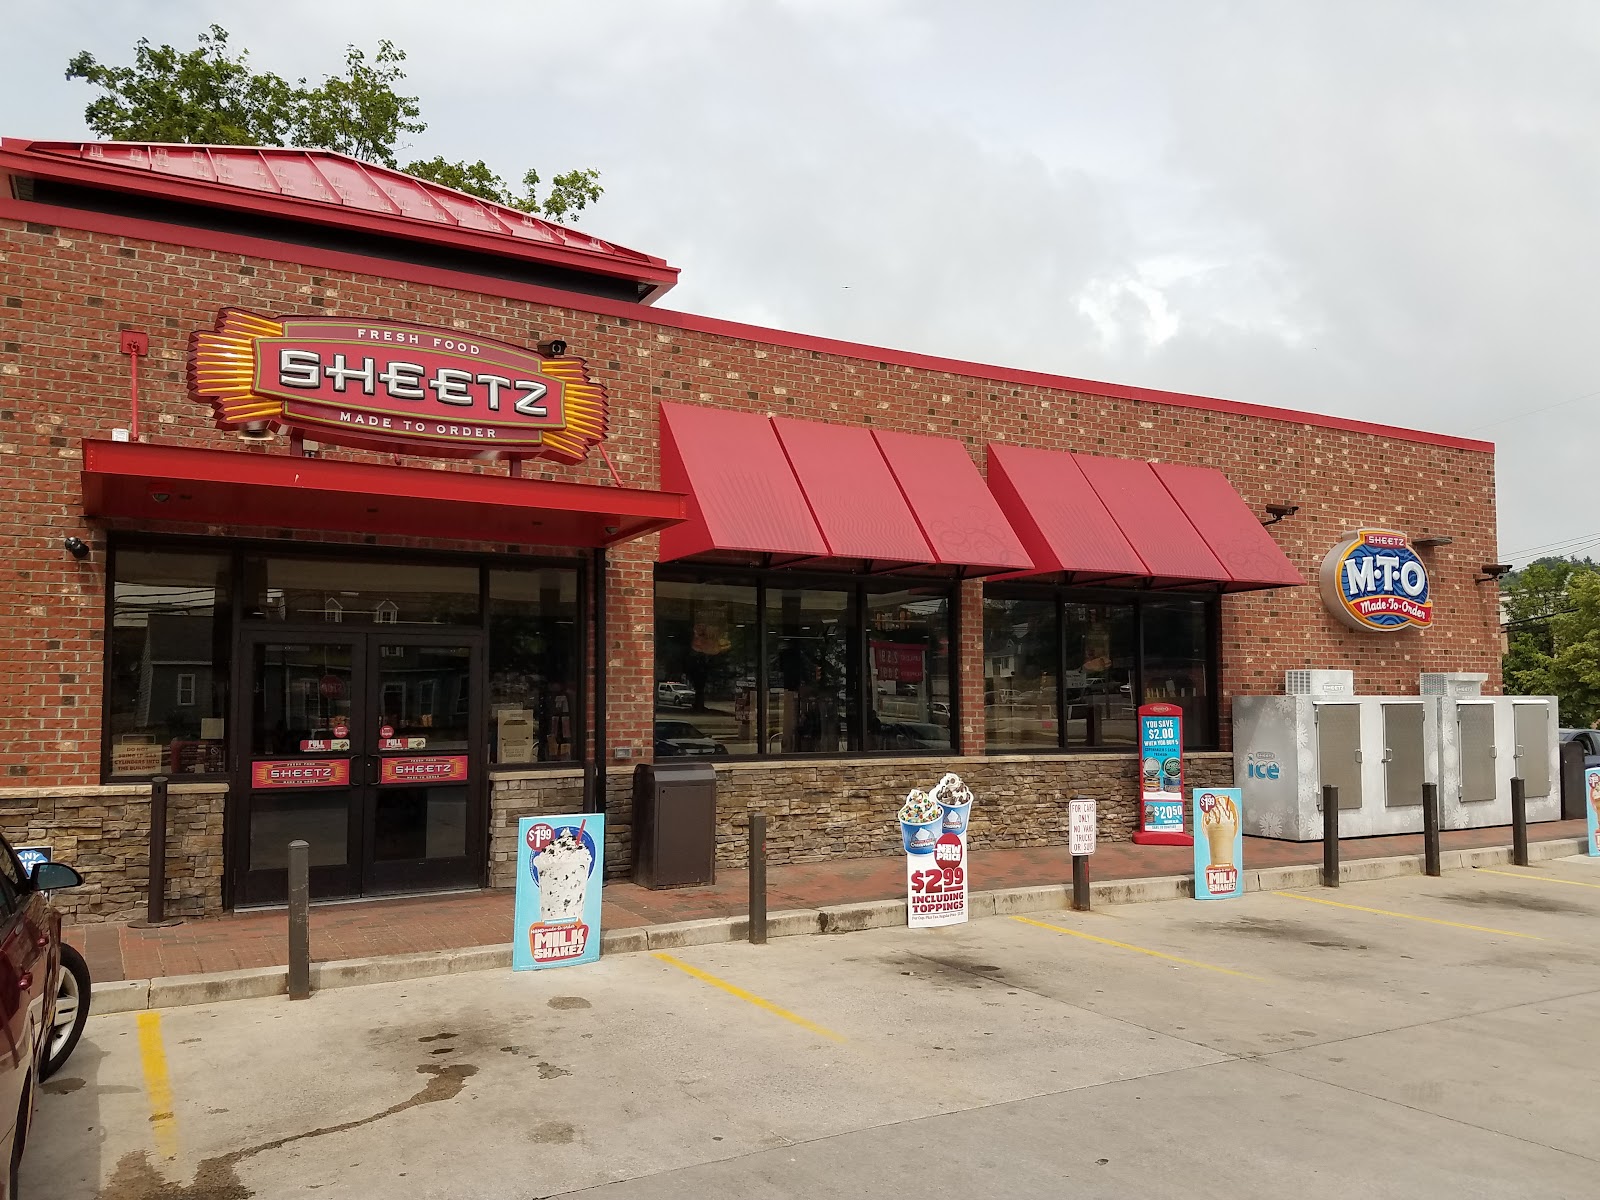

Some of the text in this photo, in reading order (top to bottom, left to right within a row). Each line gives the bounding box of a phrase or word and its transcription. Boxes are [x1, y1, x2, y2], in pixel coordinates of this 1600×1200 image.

[358, 328, 480, 354] FRESH FOOD
[279, 348, 549, 417] SHEETZ
[340, 412, 496, 438] MADE TO ORDER
[1368, 535, 1405, 546] SHEETZ
[1158, 720, 1174, 728] SAVE
[1149, 728, 1174, 739] $2.00
[308, 740, 324, 748] PULL
[396, 765, 451, 773] SHEETZ
[1248, 753, 1280, 780] ice
[270, 768, 332, 778] SHEETZ
[1084, 804, 1094, 812] CARS
[937, 844, 961, 854] NEW
[936, 853, 961, 861] PRICE
[1209, 871, 1236, 885] MILK
[1209, 883, 1236, 892] SHAKEZ
[912, 892, 963, 903] INCLUDING
[912, 901, 963, 913] TOPPINGS
[535, 929, 584, 948] MILK
[534, 944, 584, 958] SHAKEZ
